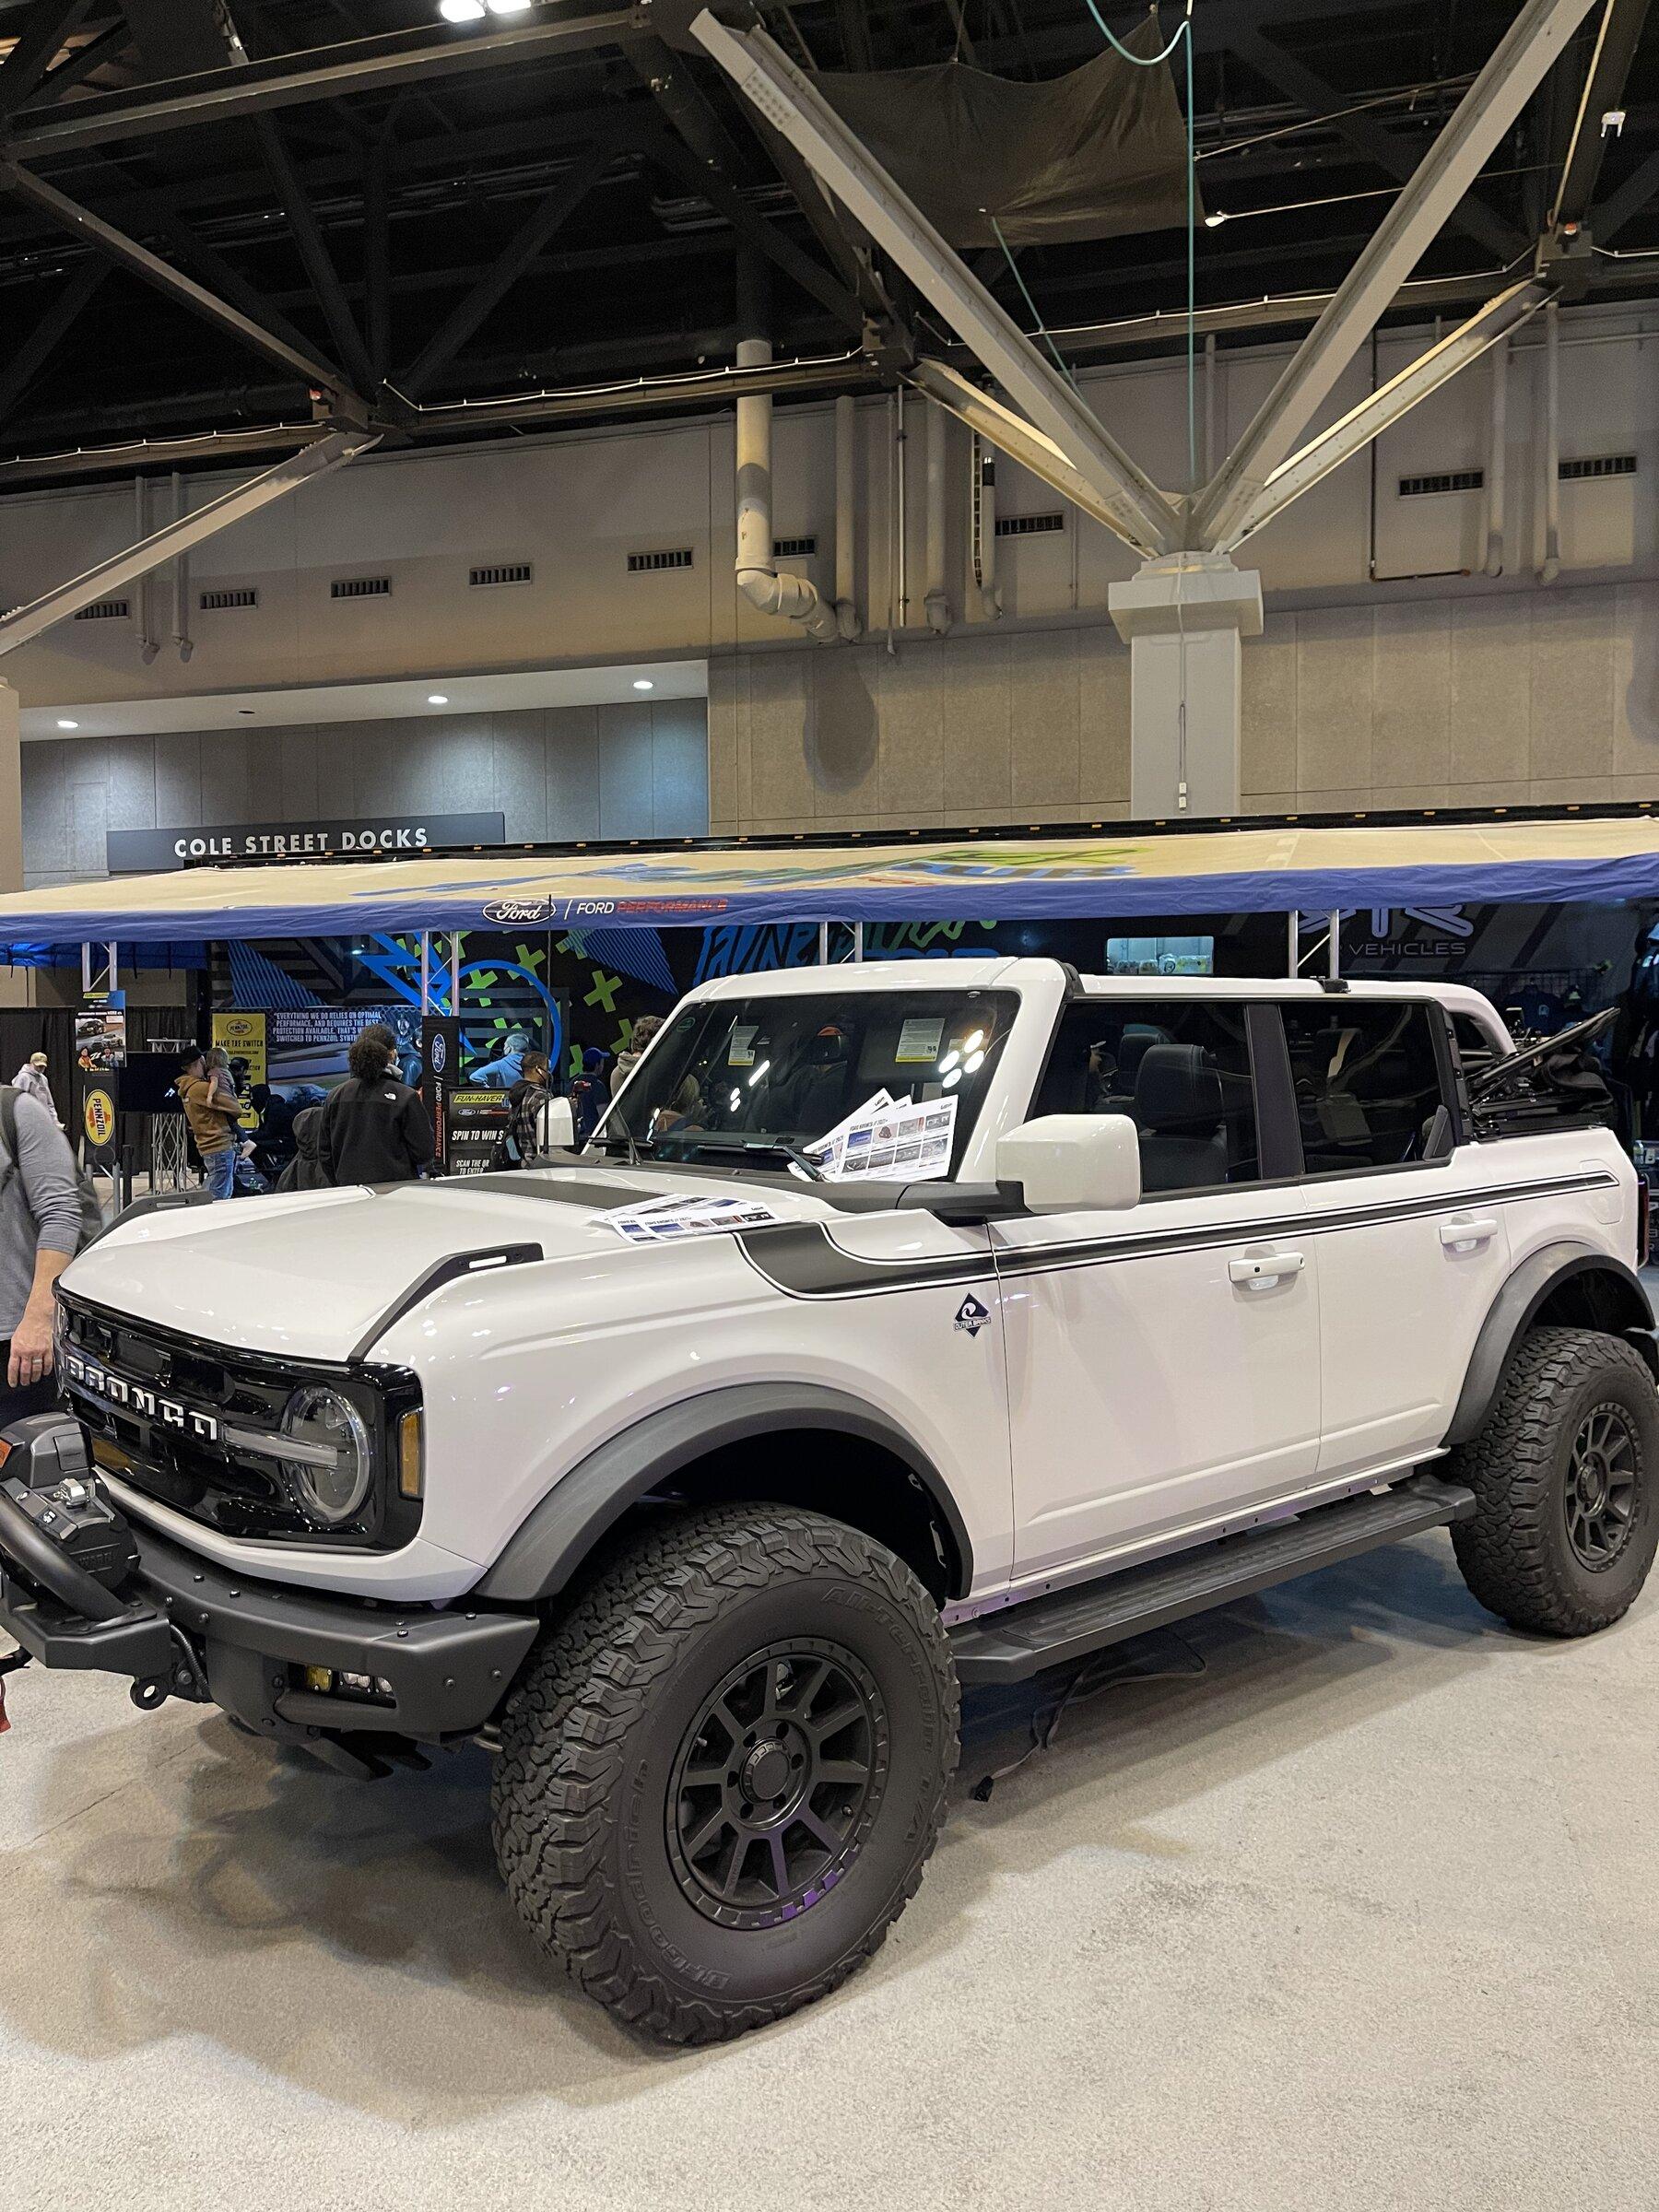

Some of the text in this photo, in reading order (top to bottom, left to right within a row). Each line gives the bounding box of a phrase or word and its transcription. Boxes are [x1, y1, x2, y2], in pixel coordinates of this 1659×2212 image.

[174, 828, 428, 857] COLE STREET DOCKS
[496, 900, 545, 921] Ford
[576, 901, 615, 915] FORD
[1348, 942, 1466, 956] VEHICLES
[358, 1011, 382, 1019] OPTIMAL
[276, 1034, 304, 1042] SWITCHED
[93, 1098, 106, 1136] PENNZOIL
[434, 1102, 443, 1159] PERFORMANCE
[452, 1130, 470, 1141] SPIN
[471, 1130, 480, 1140] TO
[481, 1130, 497, 1140] WIN
[455, 1159, 470, 1168] SCAN
[482, 1159, 490, 1168] QR
[65, 1354, 218, 1441] BRONCO
